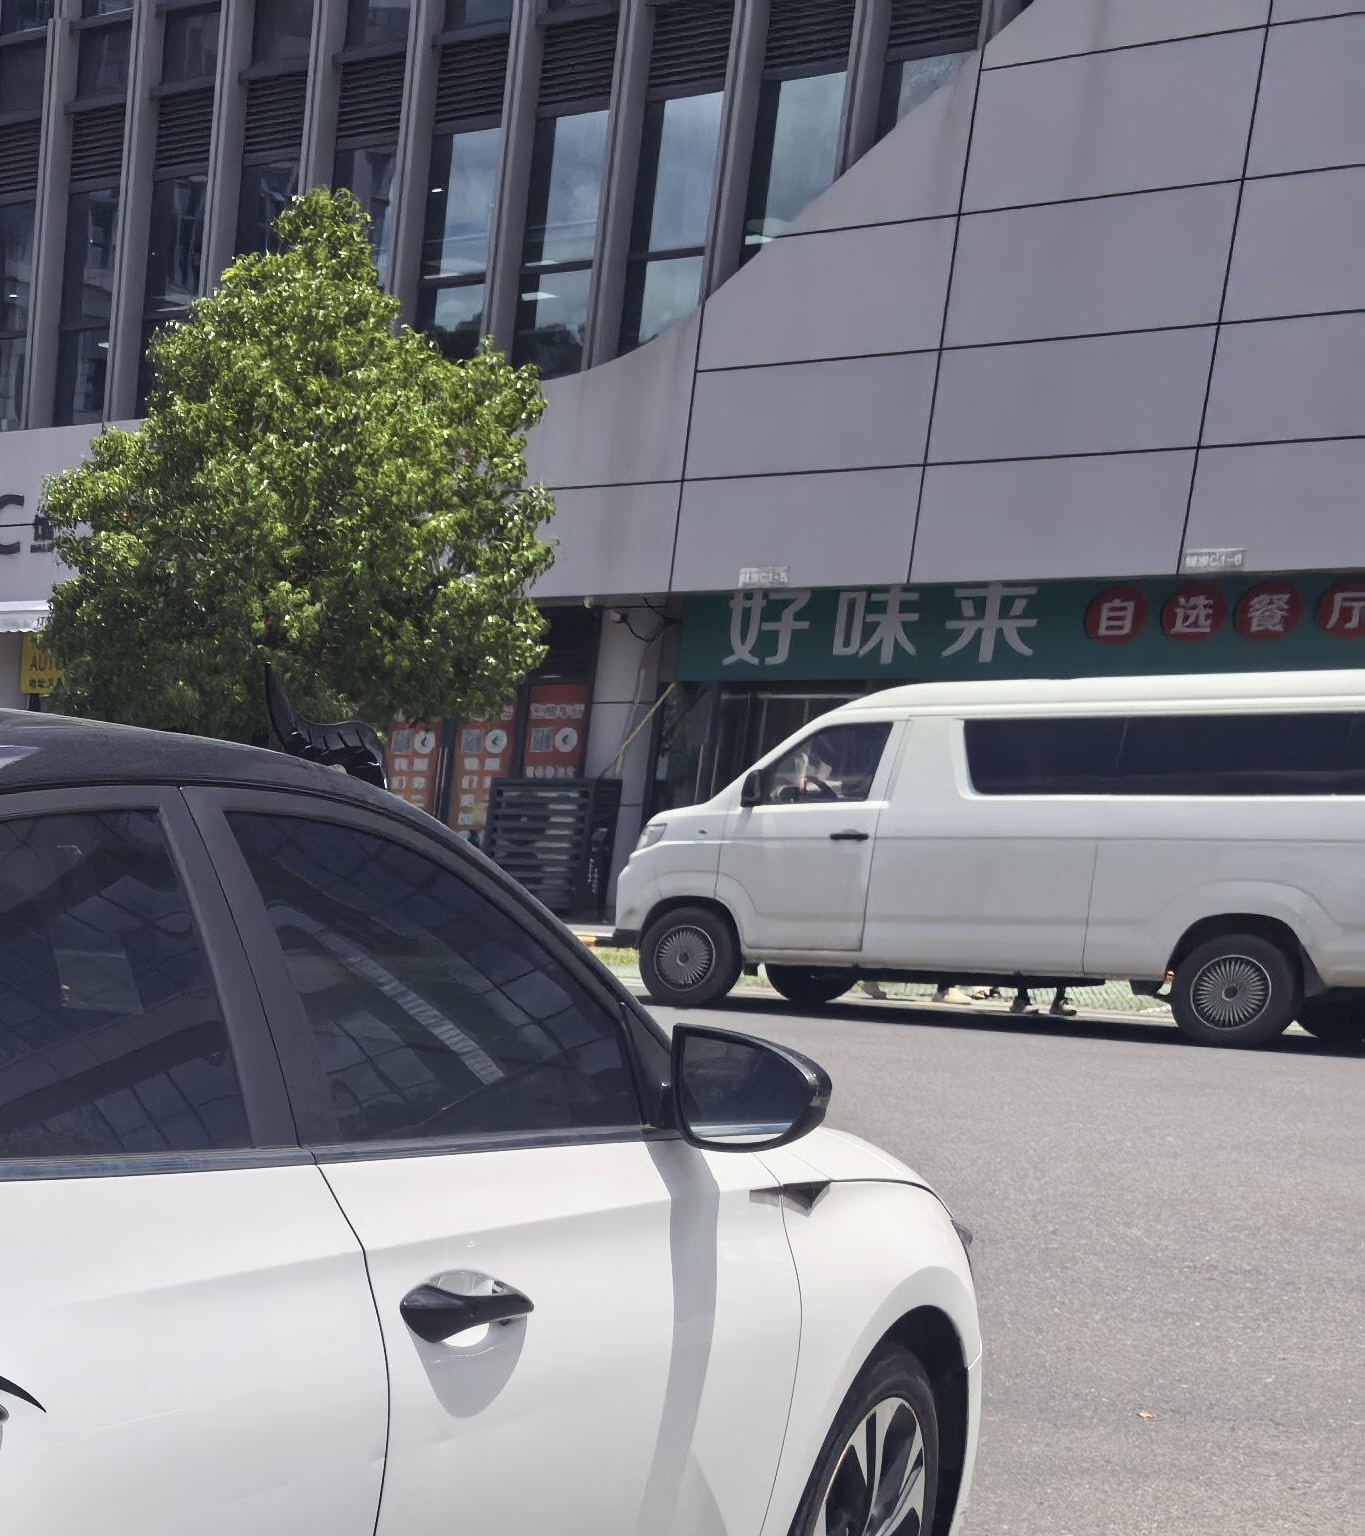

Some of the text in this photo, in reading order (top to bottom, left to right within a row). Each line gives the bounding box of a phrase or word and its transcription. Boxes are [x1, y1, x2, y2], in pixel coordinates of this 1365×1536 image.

[722, 583, 1365, 666] 好味来 自选餐厅
